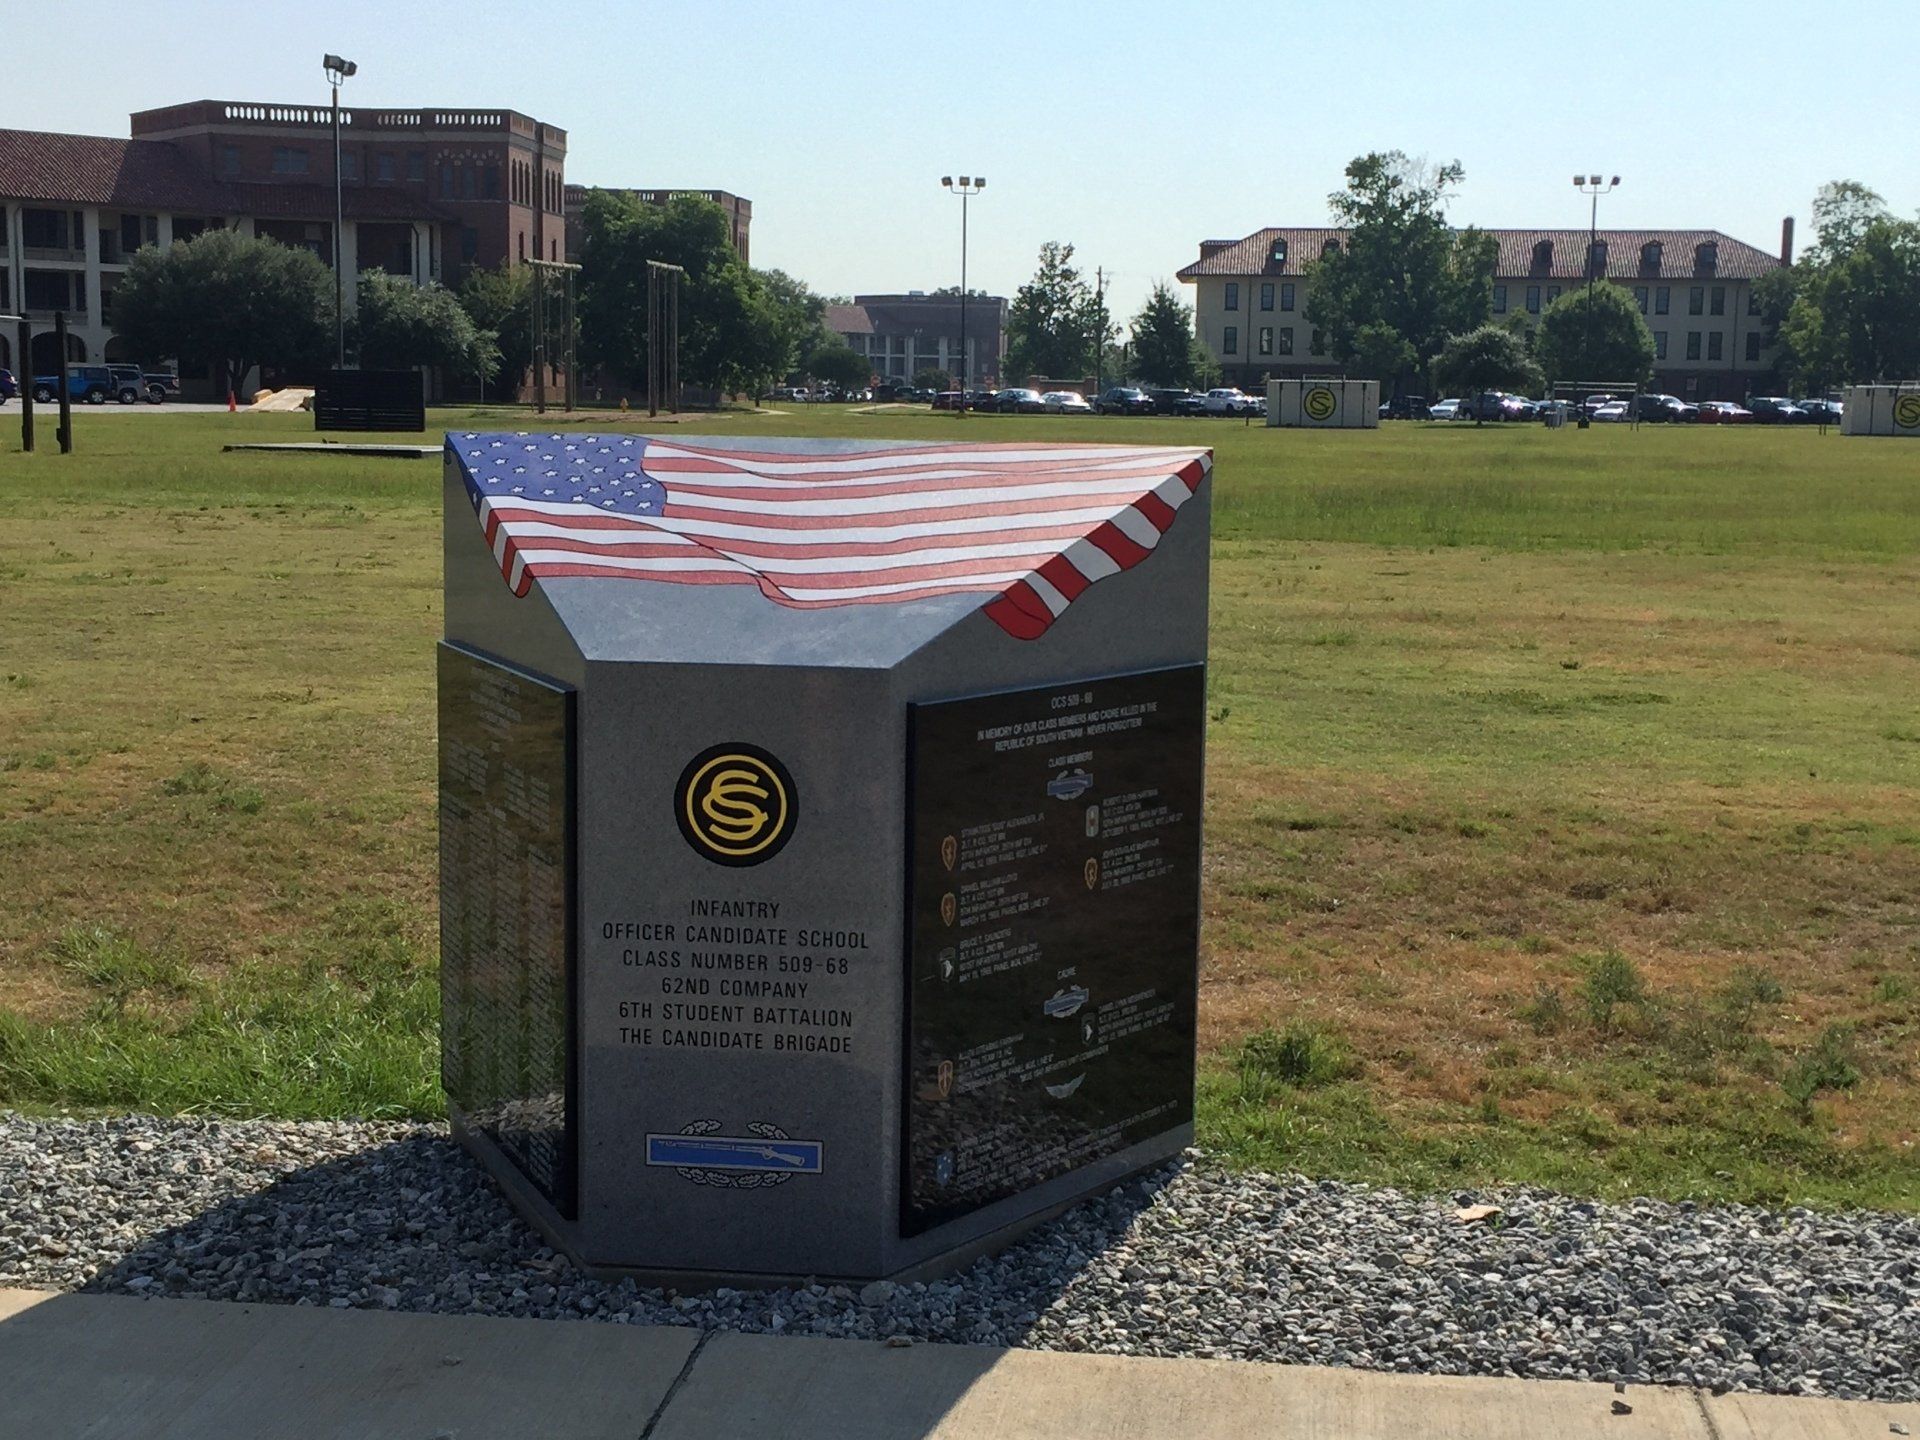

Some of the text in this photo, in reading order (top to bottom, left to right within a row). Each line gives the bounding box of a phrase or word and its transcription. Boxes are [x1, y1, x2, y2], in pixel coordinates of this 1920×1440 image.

[1051, 696, 1066, 709] OCS
[985, 725, 1012, 740] MEMORY
[1013, 723, 1022, 735] OF
[1023, 721, 1036, 733] OUR
[1038, 717, 1057, 731] CLASS
[1058, 713, 1086, 728] MEMBERS
[1087, 711, 1099, 723] AND
[1146, 702, 1157, 713] THE
[994, 736, 1024, 752] REPUBLIC
[1027, 735, 1034, 746] OF
[1036, 731, 1056, 745] SOUTH
[1057, 727, 1082, 741] VIETNAM
[1086, 723, 1105, 736] NEVER
[691, 899, 780, 919] INFANTRY
[602, 922, 869, 949] OFFICER CANDIDATE SCHOOL
[622, 949, 848, 975] CLASS NUMBER 509-68
[661, 977, 808, 999] 62ND COMPANY
[618, 1001, 852, 1028] 6TH STUDENT BATTALION
[619, 1027, 852, 1053] THE CANDIDATE BRIGADE
